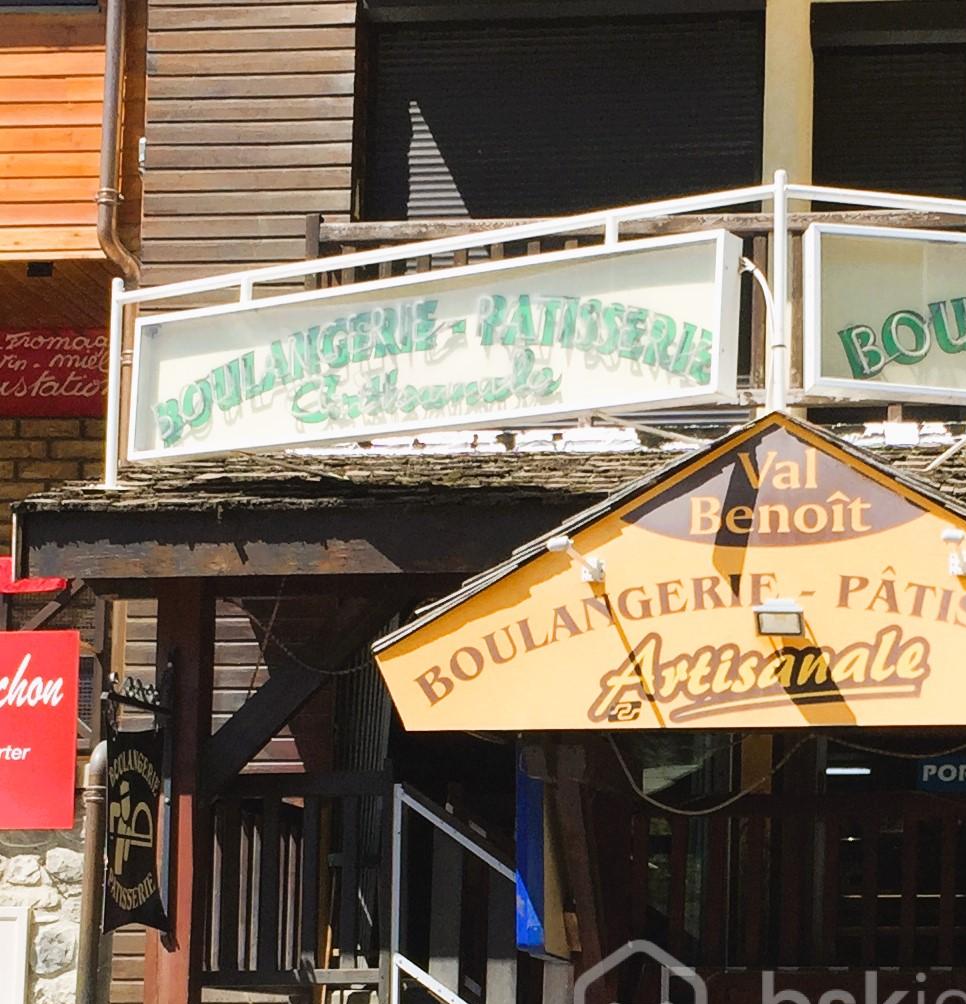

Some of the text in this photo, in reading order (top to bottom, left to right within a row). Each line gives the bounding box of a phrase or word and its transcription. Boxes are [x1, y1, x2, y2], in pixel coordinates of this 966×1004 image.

[151, 299, 439, 449] BOULANGERIE
[737, 447, 818, 491] Val
[689, 491, 872, 535] Benoît
[413, 572, 779, 706] BOULANGERIE
[587, 623, 931, 723] Artisanale
[108, 749, 162, 797] BOULANGERIE
